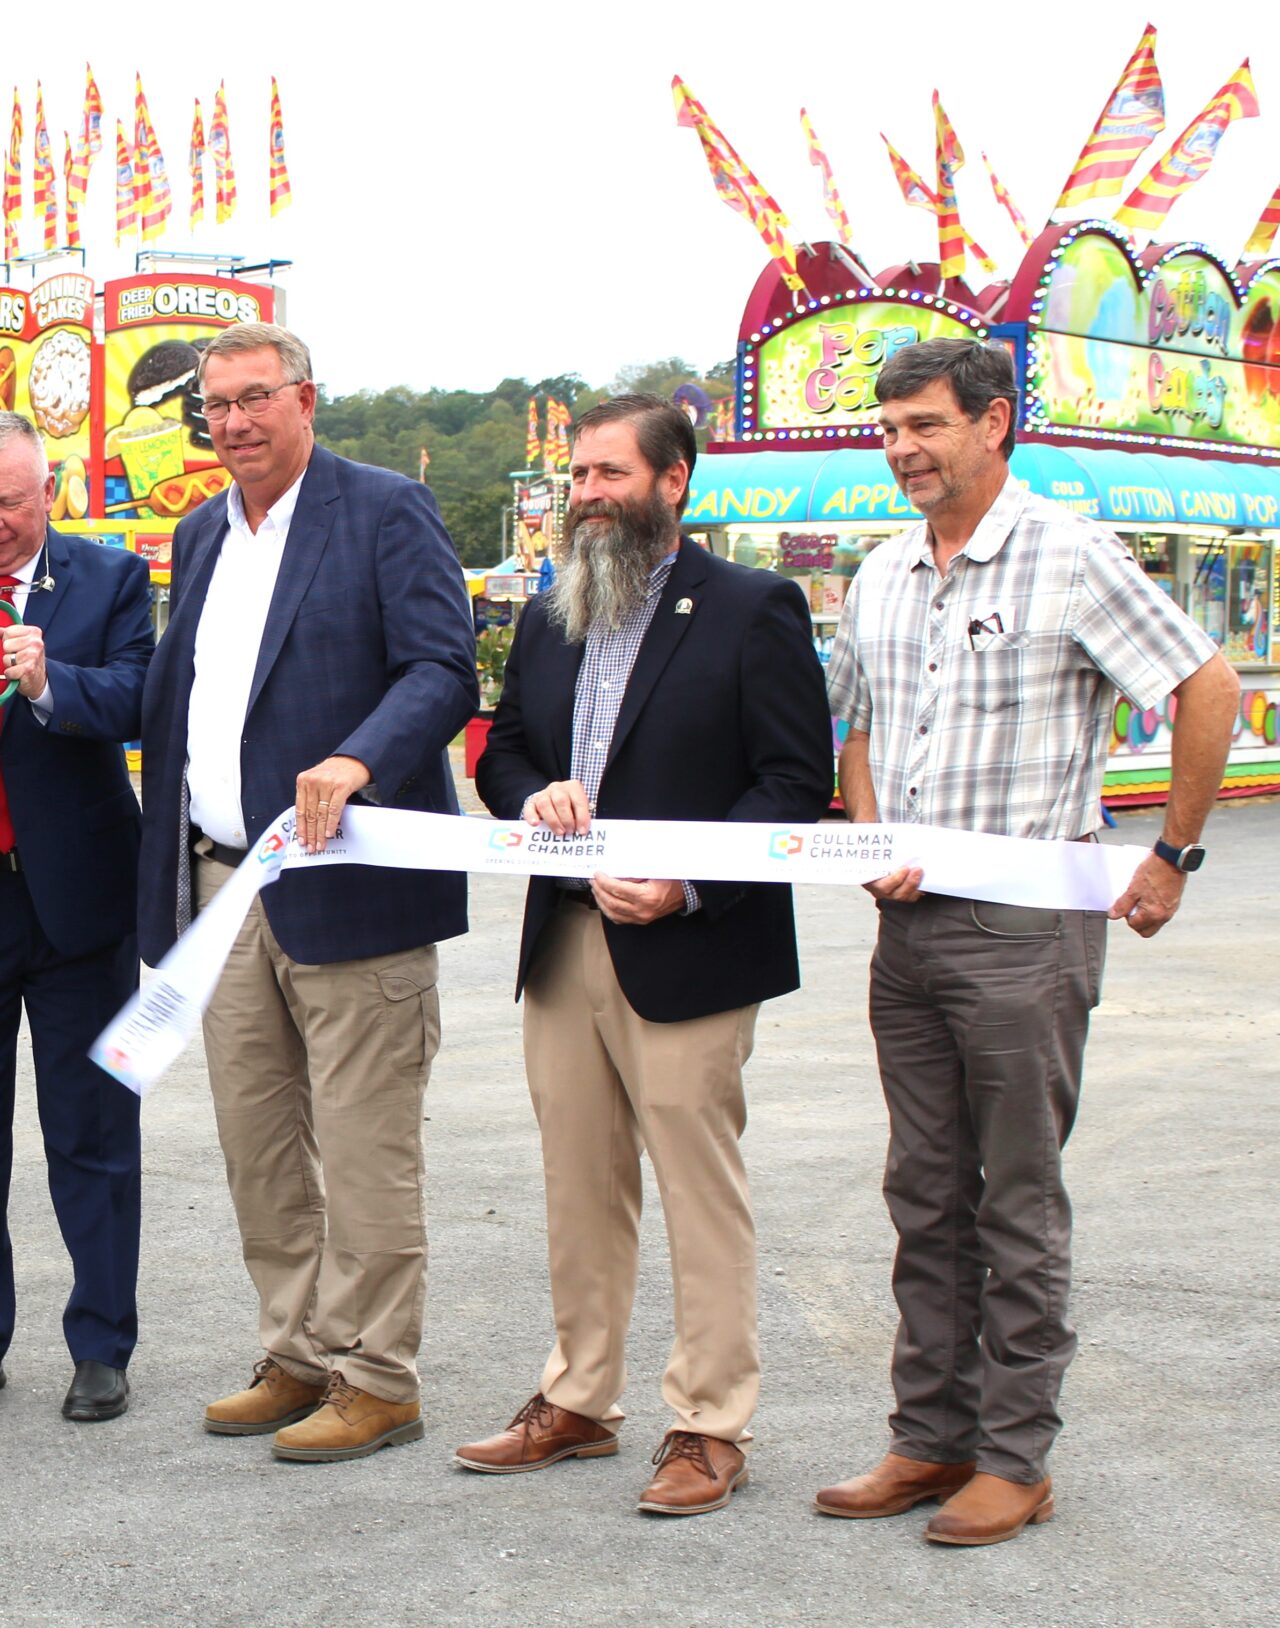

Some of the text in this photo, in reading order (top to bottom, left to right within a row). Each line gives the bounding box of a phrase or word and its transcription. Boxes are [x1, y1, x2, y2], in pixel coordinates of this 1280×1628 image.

[30, 274, 94, 315] FUNNEL
[121, 288, 152, 306] DEEP
[154, 284, 258, 323] OREOS
[37, 298, 86, 328] CAKES
[121, 304, 154, 322] FRIED
[1148, 270, 1231, 357] Cotton
[819, 322, 919, 369] Pop
[804, 368, 879, 412] Cor
[1148, 351, 1228, 430] Candy
[822, 484, 922, 515] APPL
[1051, 480, 1085, 496] COLD
[1108, 486, 1279, 523] COTTON CANDY POP
[527, 843, 605, 857] CHAMBER
[531, 830, 607, 843] CULLMAN
[813, 833, 894, 846] CULLMAN
[810, 846, 893, 861] CHAMBER
